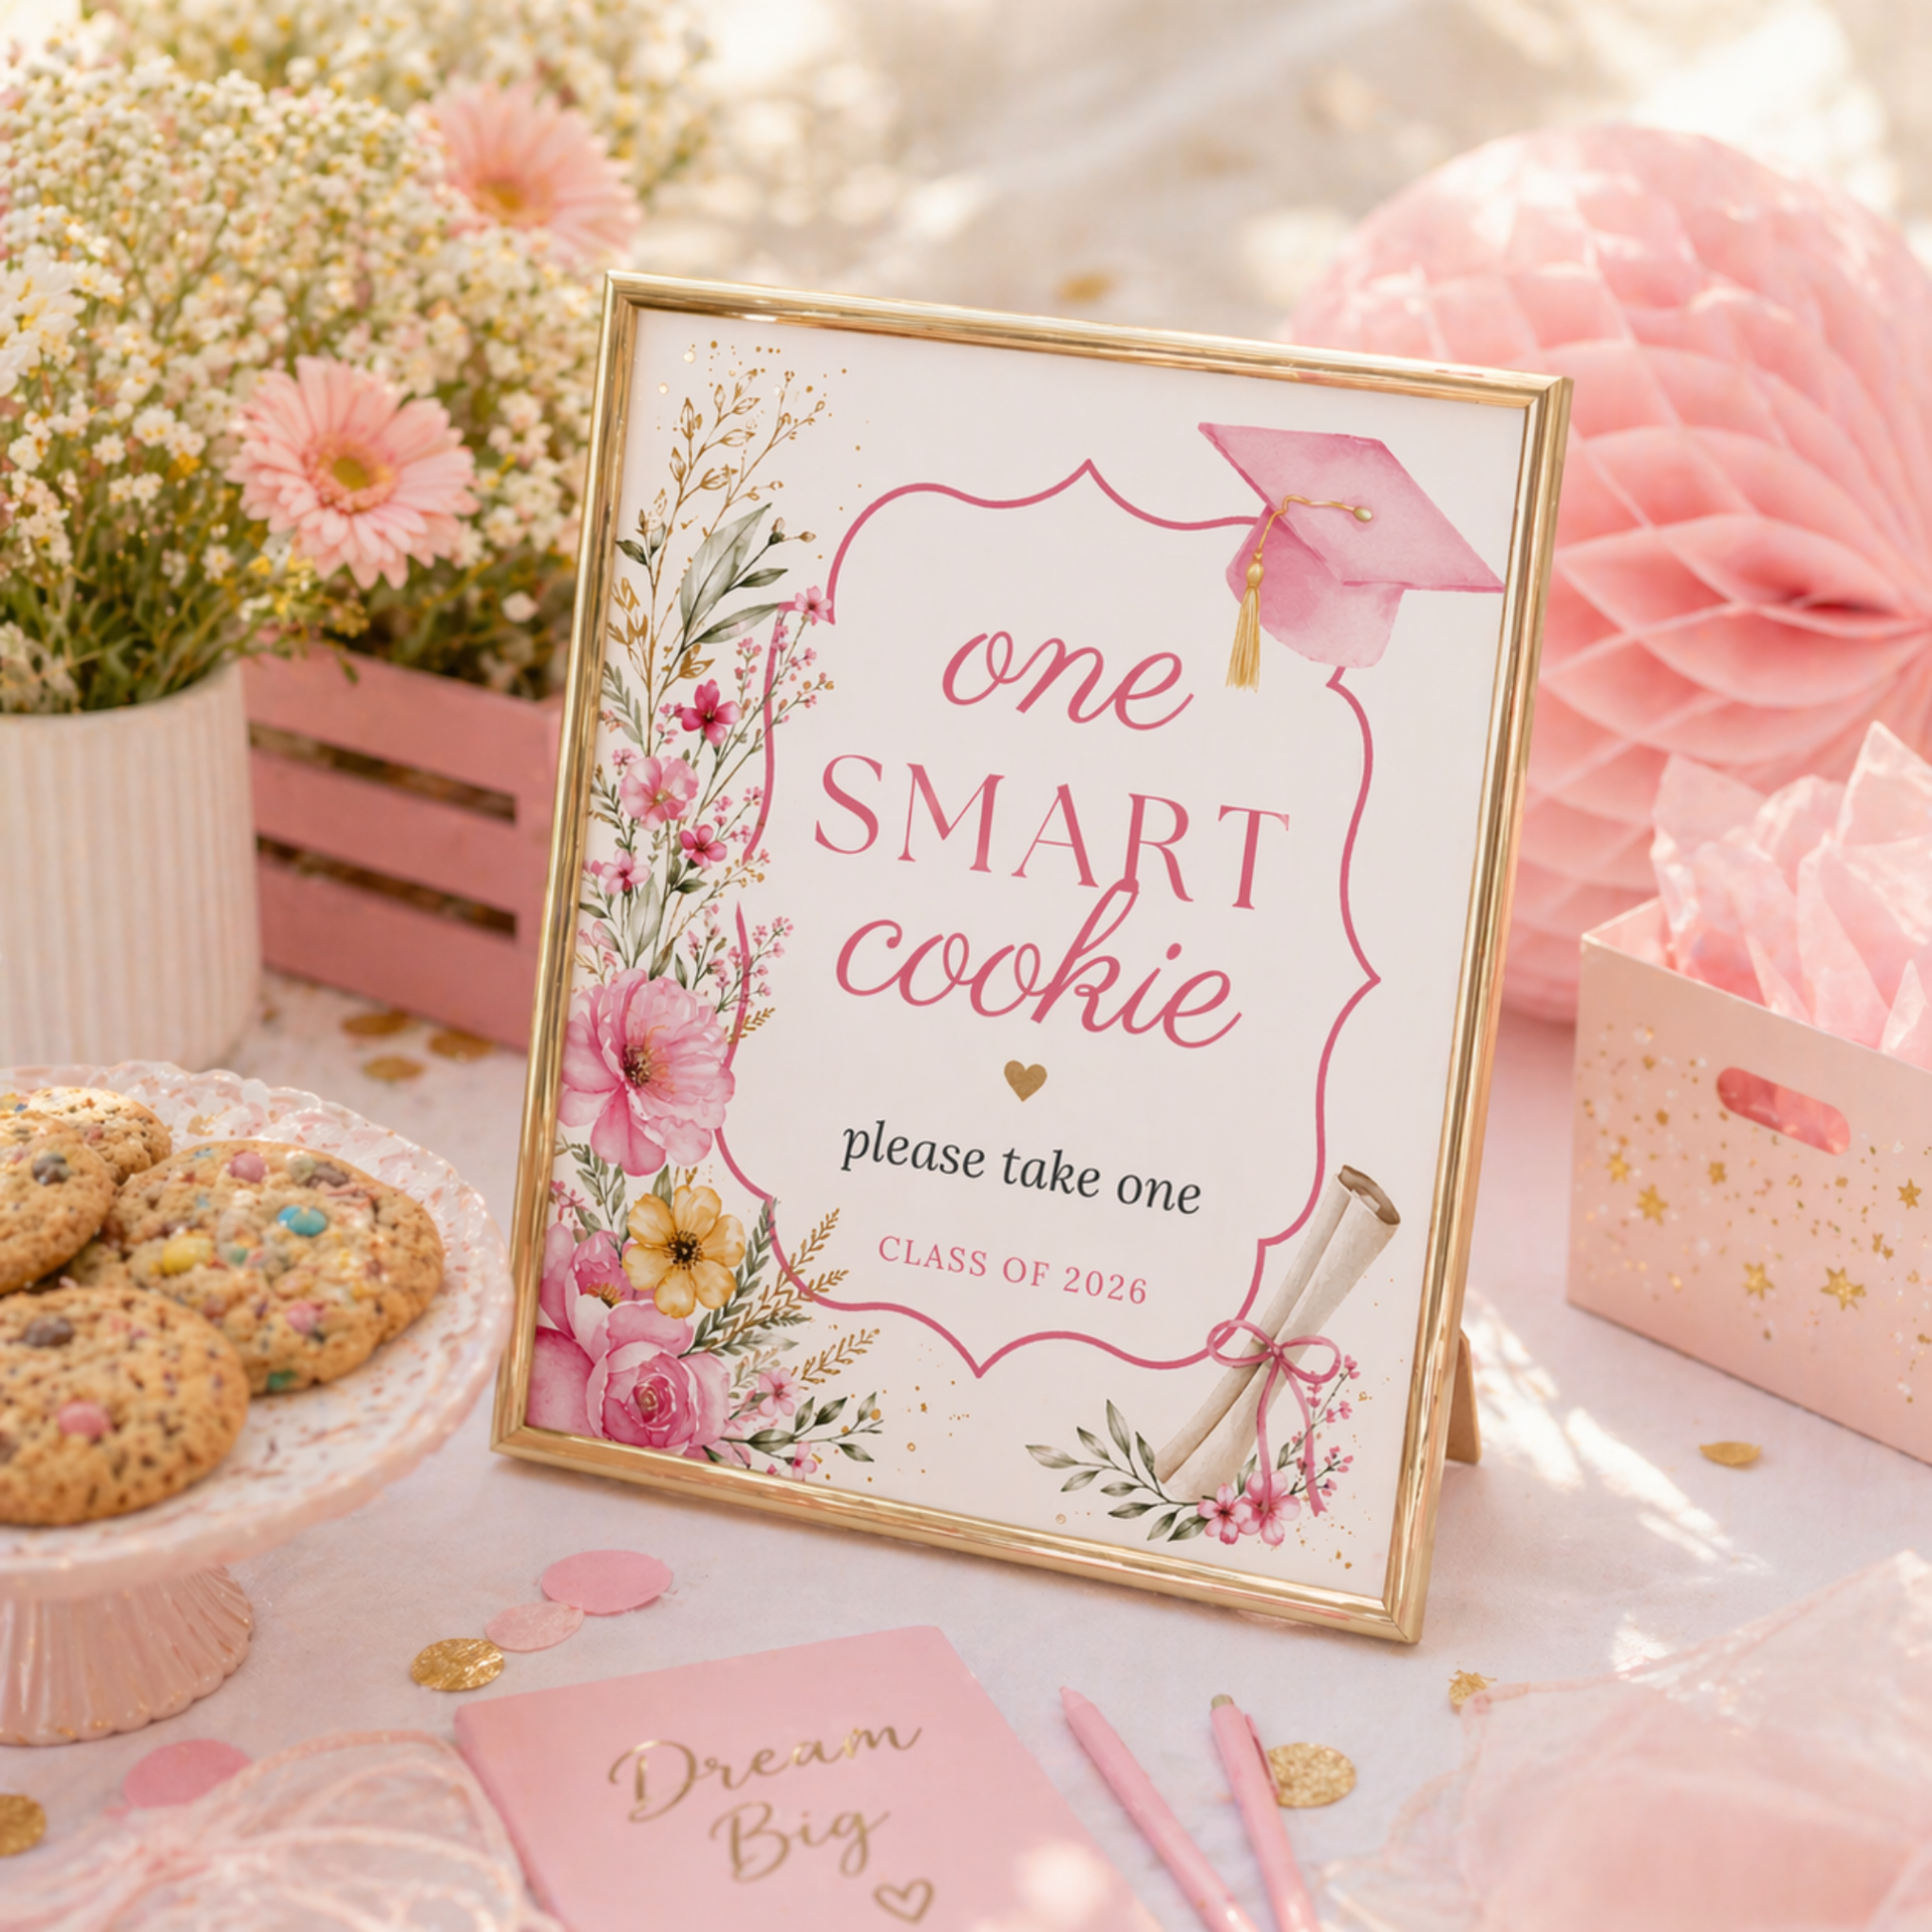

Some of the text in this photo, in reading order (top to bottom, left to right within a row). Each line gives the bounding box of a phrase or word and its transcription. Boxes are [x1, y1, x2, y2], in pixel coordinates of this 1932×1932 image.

[942, 630, 1194, 731] one
[814, 755, 1290, 910] SMART
[836, 878, 1242, 1048] cookie
[841, 1120, 1201, 1214] please take one
[879, 1236, 1148, 1305] CLASS OF 2026
[609, 1726, 922, 1823] Dream
[709, 1801, 891, 1883] Big
